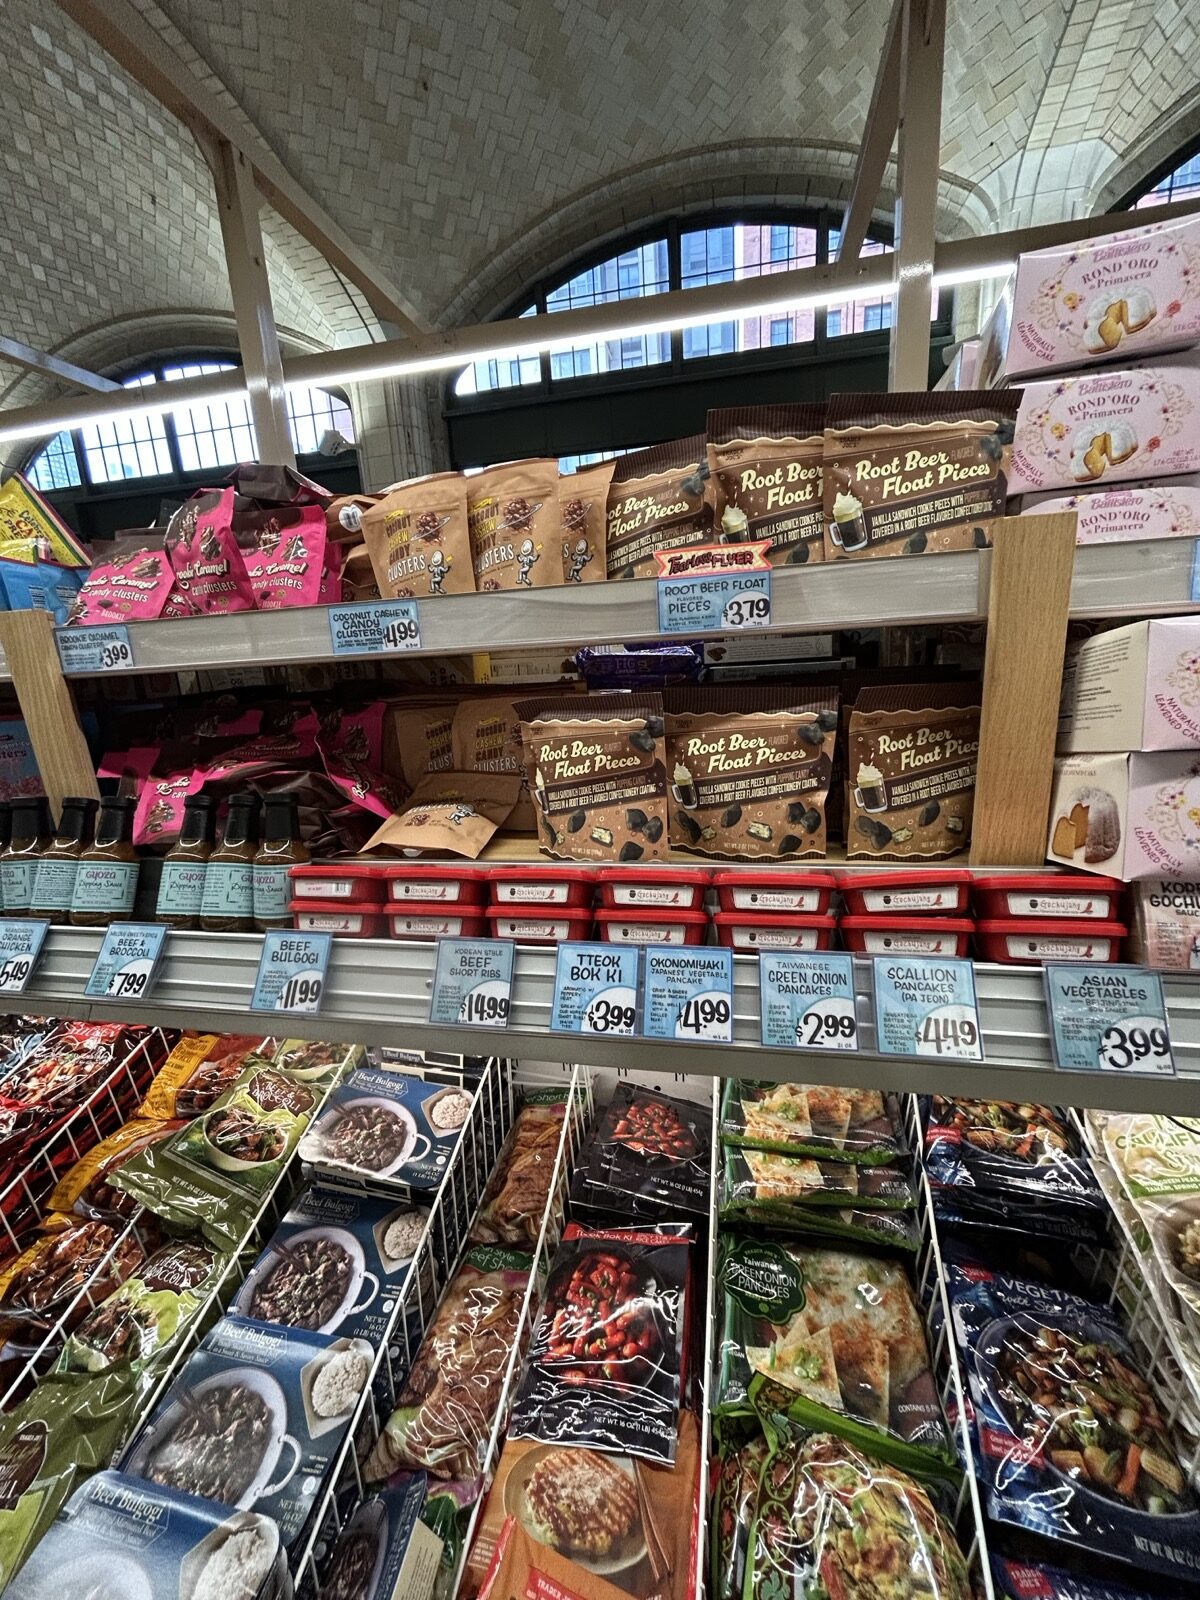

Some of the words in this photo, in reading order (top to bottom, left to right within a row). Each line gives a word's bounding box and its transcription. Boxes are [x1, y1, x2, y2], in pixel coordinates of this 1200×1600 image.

[1082, 258, 1159, 285] ROND'ORO
[1098, 270, 1151, 289] Primavera
[1027, 322, 1056, 352] NATURALLY
[1035, 344, 1056, 362] CAKE
[1068, 394, 1141, 417] ROND'ORO
[1082, 405, 1134, 421] Primavera
[856, 460, 901, 481] Root
[904, 450, 950, 472] Beer
[1016, 449, 1045, 479] NATURALLY
[741, 468, 784, 492] Root
[786, 462, 823, 483] Beer
[882, 470, 935, 499] Float
[937, 462, 991, 484] Pieces
[1026, 470, 1046, 487] CAKE
[622, 496, 656, 515] Beer
[766, 483, 814, 510] Float
[872, 512, 892, 527] VANILLA
[892, 505, 917, 521] SANDWICH
[917, 501, 935, 516] COOKIE
[935, 497, 951, 512] PIECES
[951, 494, 964, 509] WITH
[608, 512, 643, 541] Float
[643, 500, 690, 524] Pieces
[905, 517, 918, 532] ROOT
[1079, 511, 1151, 530] ROND'ORO
[1094, 522, 1144, 536] Primavera
[195, 558, 229, 577] Caramel
[266, 561, 309, 575] Caramel
[710, 550, 755, 569] FLYER
[111, 575, 159, 590] Caramel
[205, 580, 238, 595] clusters
[269, 577, 303, 590] clusters
[665, 584, 699, 597] ROOT
[700, 581, 729, 594] BEER
[732, 578, 768, 591] FLOAT
[112, 588, 149, 603] clusters
[333, 611, 371, 622] COCONUT
[374, 608, 410, 619] CASHEW
[668, 600, 712, 615] PIECES
[722, 597, 771, 627] $3.79
[336, 627, 384, 640] CLUSTERS
[342, 618, 381, 630] CANDY
[383, 619, 420, 649] $4.99
[1154, 693, 1183, 731] LEAVENED
[687, 737, 726, 757] Root
[728, 733, 768, 752] Beer
[878, 734, 915, 756] Root
[915, 727, 954, 747] Beer
[539, 744, 568, 763] Root
[570, 740, 603, 759] Beer
[707, 754, 752, 774] Float
[755, 747, 808, 767] Pieces
[900, 745, 942, 771] Float
[554, 758, 592, 780] Float
[594, 751, 641, 772] Pieces
[1133, 826, 1161, 864] LEAVENED
[1145, 831, 1184, 867] NATURALLY
[79, 880, 103, 891] Dipping
[104, 880, 123, 890] Sauce
[2, 932, 33, 942] ORANGE
[117, 938, 140, 947] BEEF
[280, 940, 312, 952] BEEF
[109, 946, 151, 957] BROCCOLI
[271, 950, 320, 965] BULGOGI
[454, 947, 483, 956] KOREAN
[484, 949, 504, 957] STYLE
[576, 953, 622, 968] TTEOK
[460, 956, 493, 969] BEEF
[650, 957, 725, 971] OKONOMIYAKI
[776, 960, 832, 972] TAIWANESE
[449, 967, 479, 978] SHORT
[481, 969, 502, 979] RIBS
[570, 966, 601, 981] BOK
[606, 968, 622, 983] KI
[651, 968, 686, 977] JAPANESE
[688, 970, 730, 981] VEGETABLE
[666, 976, 704, 985] PANCAKE
[768, 969, 808, 984] GREEN
[811, 971, 848, 987] ONION
[886, 966, 958, 983] SCALLION
[1081, 975, 1128, 989] ASIAN
[108, 970, 148, 997] $7.99
[777, 984, 833, 997] PANCAKES
[893, 980, 955, 994] PANCAKES
[1060, 985, 1149, 1001] VEGETABLES
[277, 978, 322, 1010] $11.99
[901, 991, 918, 1003] (PA
[920, 993, 950, 1005] JEON)
[460, 992, 511, 1022] $14.99
[587, 999, 637, 1033] $3.99
[676, 998, 731, 1034] $4.99
[794, 1011, 857, 1046] $2.99
[914, 1015, 978, 1055] $4.49
[1097, 1026, 1171, 1069] $3.99
[357, 1071, 375, 1083] Beef
[375, 1073, 405, 1092] Bulgogi
[305, 1194, 324, 1207] Beef
[324, 1197, 356, 1213] Bulgogi
[737, 1275, 790, 1299] PANCAKES
[764, 1270, 797, 1288] ONION
[363, 1314, 376, 1324] NET
[377, 1323, 387, 1333] OZ
[222, 1323, 249, 1339] Beef
[246, 1328, 285, 1350] Bulgogi
[593, 1416, 607, 1424] NET
[91, 1480, 121, 1506] Beef
[117, 1488, 168, 1524] Bulgogi
[536, 1577, 563, 1597] TRADER
